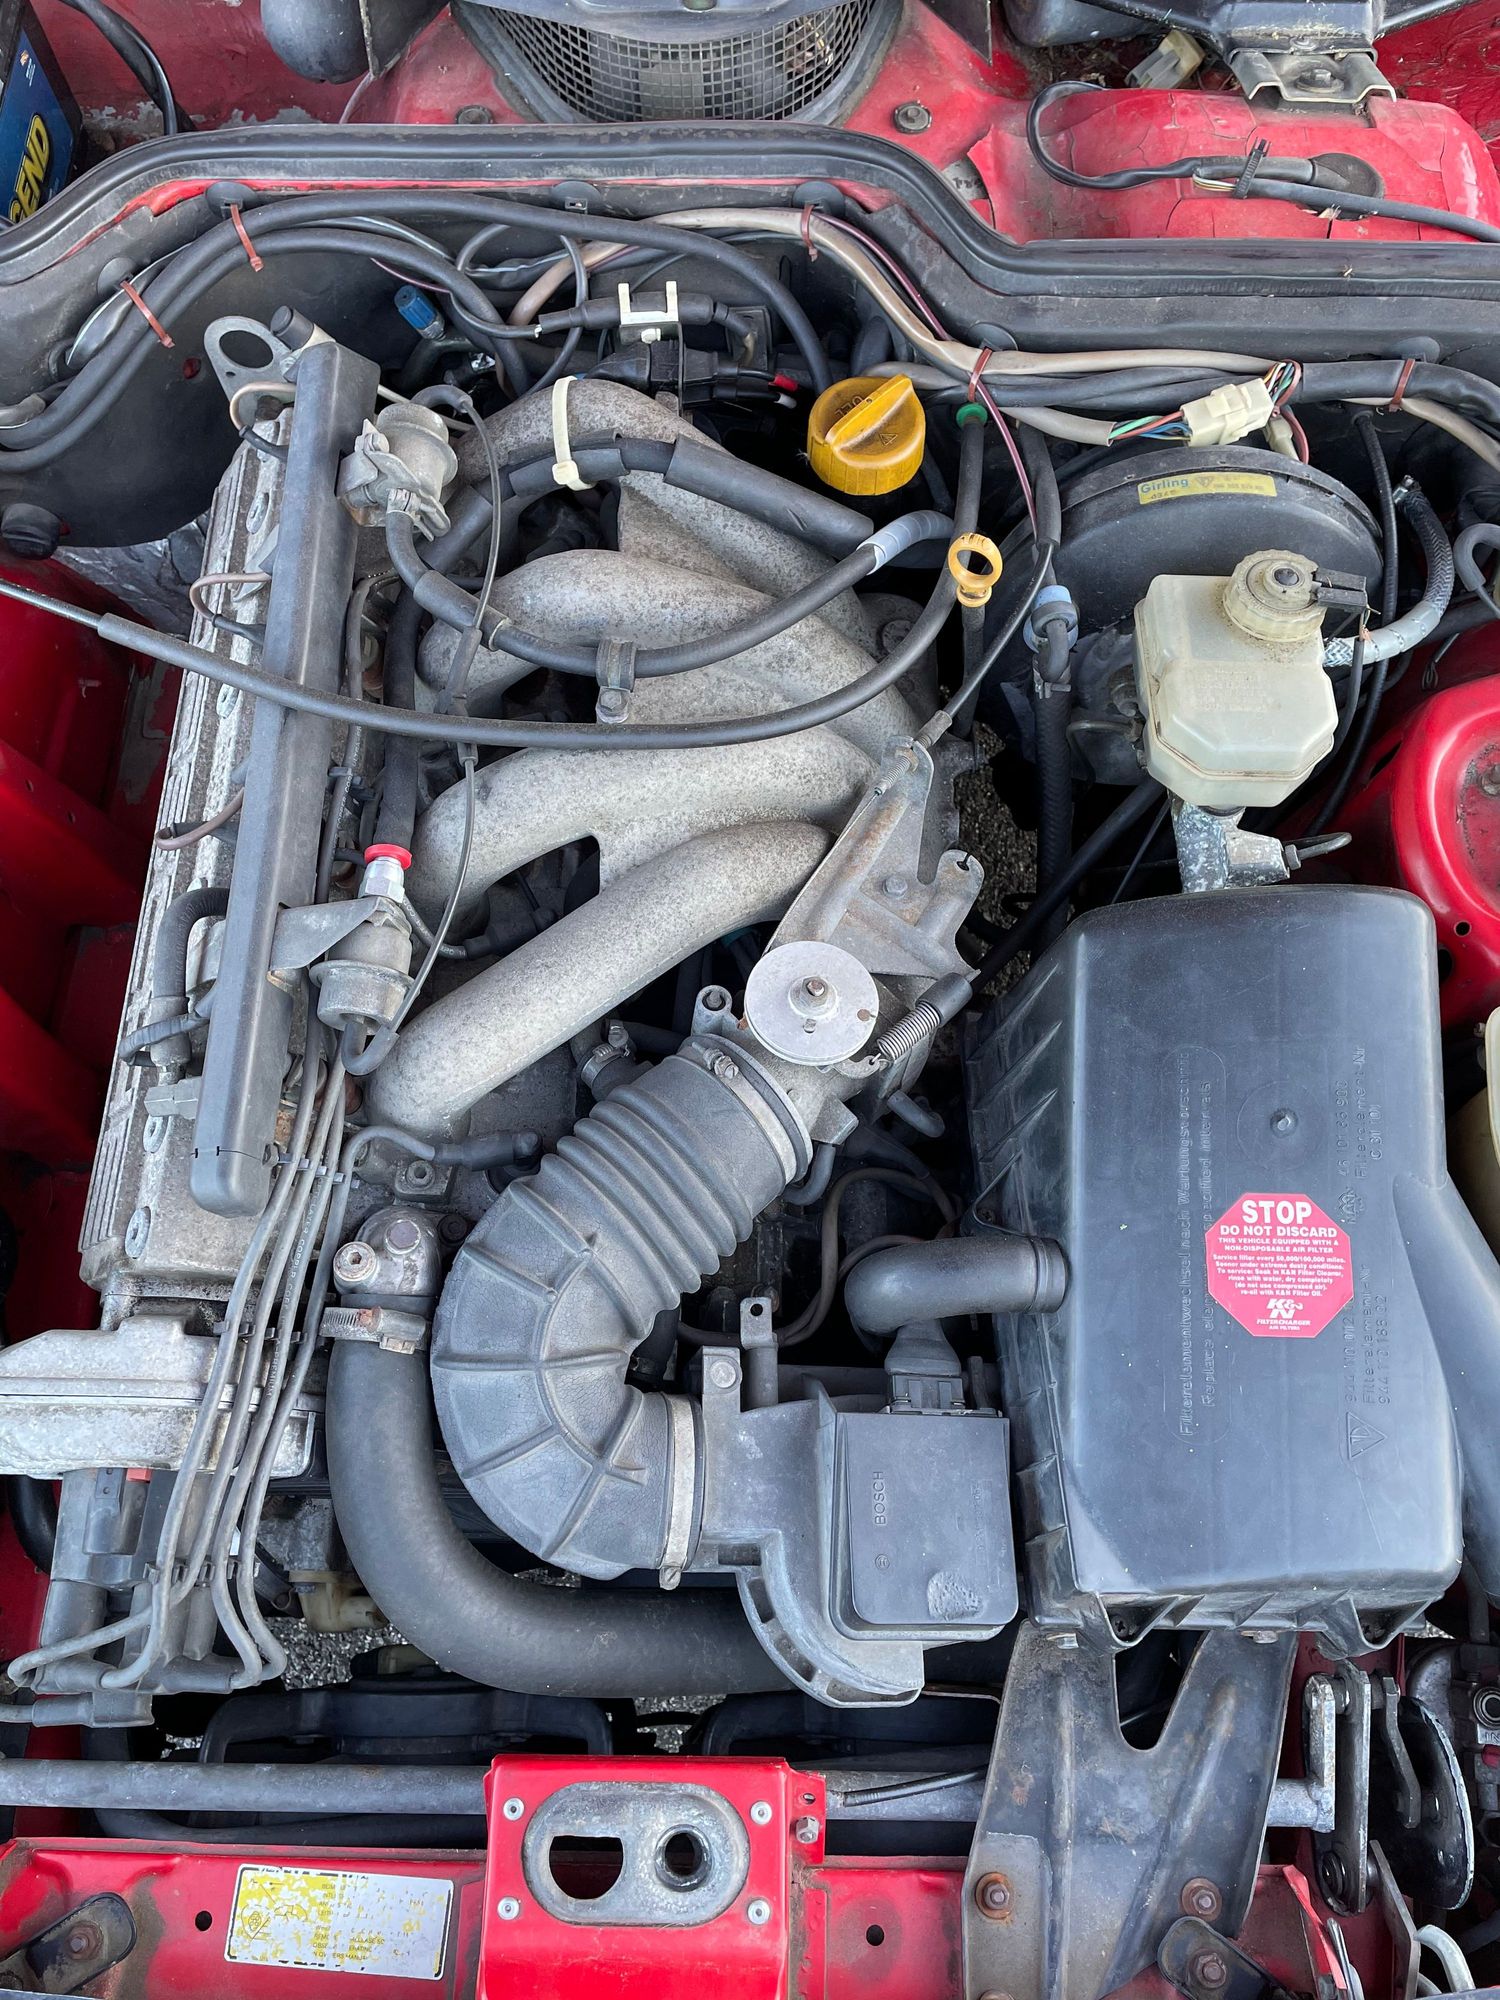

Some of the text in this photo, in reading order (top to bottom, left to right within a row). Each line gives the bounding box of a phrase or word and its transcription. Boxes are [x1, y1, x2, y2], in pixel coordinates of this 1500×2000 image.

[8, 113, 50, 223] GEND
[1140, 478, 1190, 494] Girling
[1241, 1199, 1312, 1225] STOP
[1220, 1225, 1337, 1238] DO NOT DISCARD
[290, 1238, 306, 1279] COPPER
[1289, 1262, 1307, 1270] dusty
[1266, 1298, 1304, 1319] K&N
[872, 1471, 887, 1525] BOSCH
